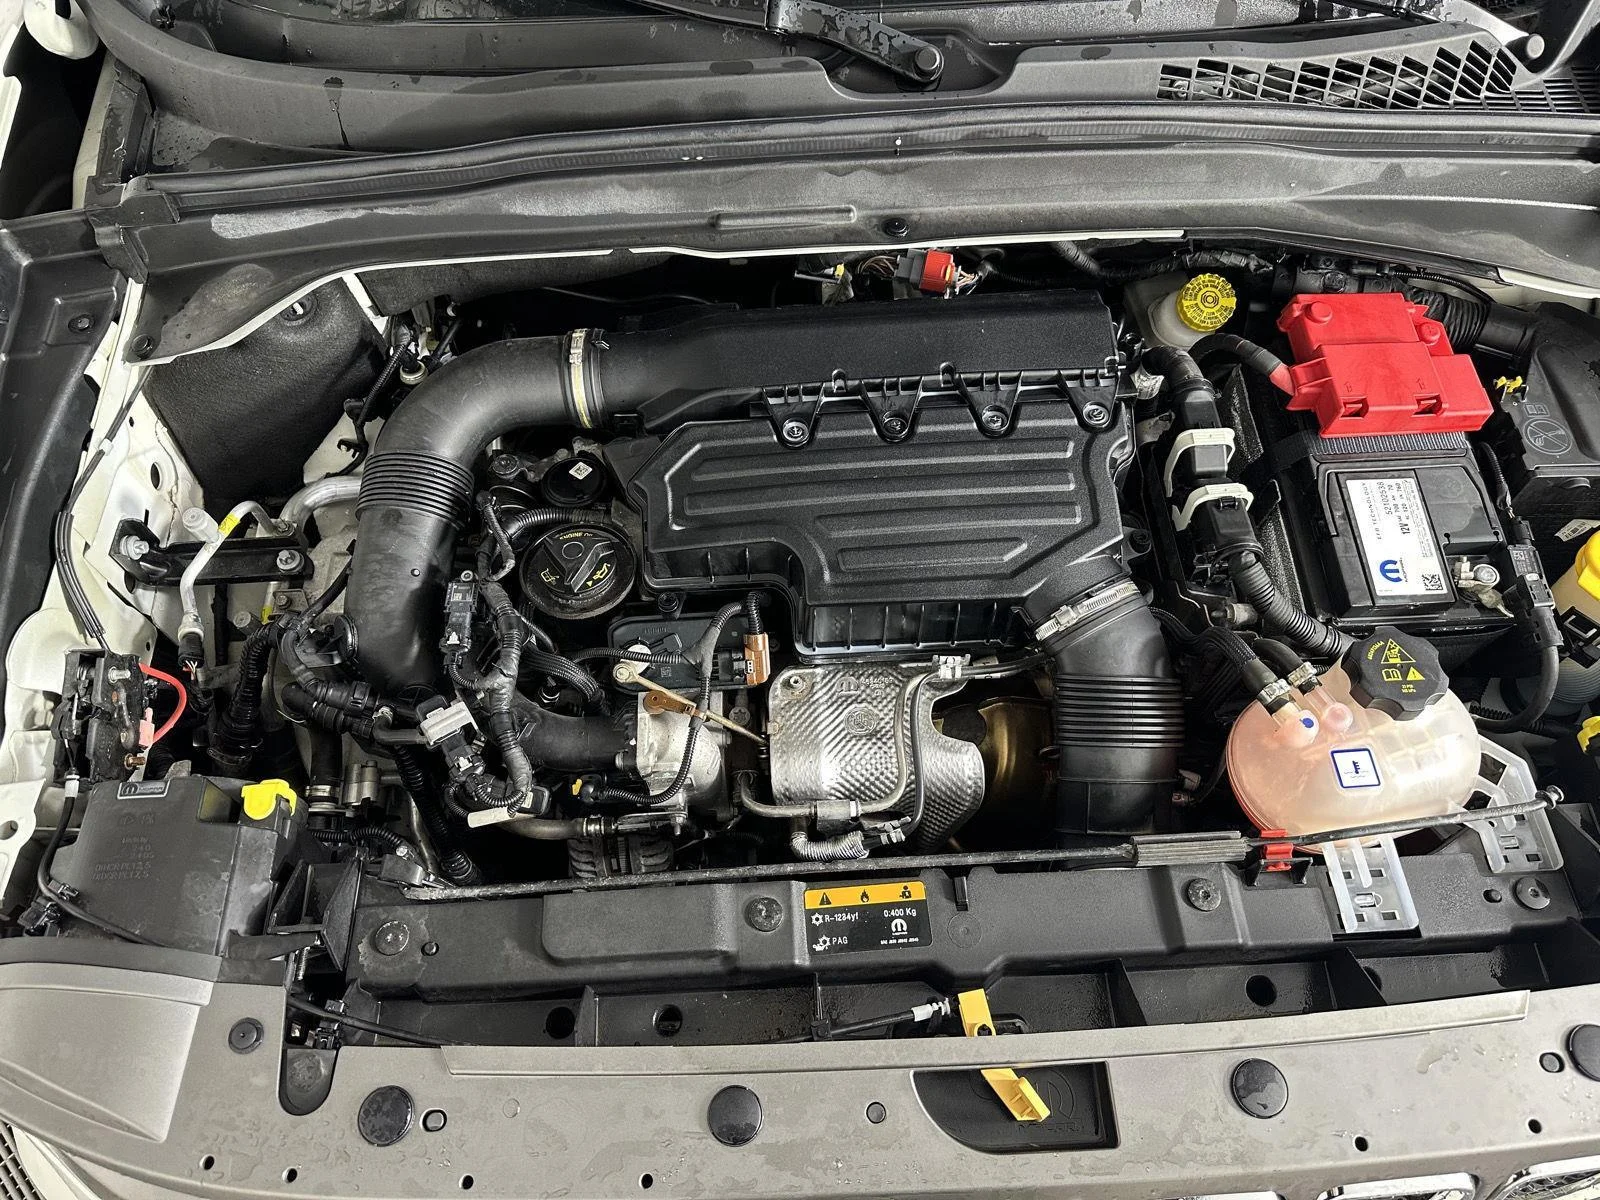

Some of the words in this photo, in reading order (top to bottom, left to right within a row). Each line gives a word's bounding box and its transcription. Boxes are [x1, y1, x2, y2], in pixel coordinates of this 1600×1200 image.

[1400, 522, 1410, 534] 12V
[906, 908, 917, 917] Kg
[832, 936, 848, 945] PAG
